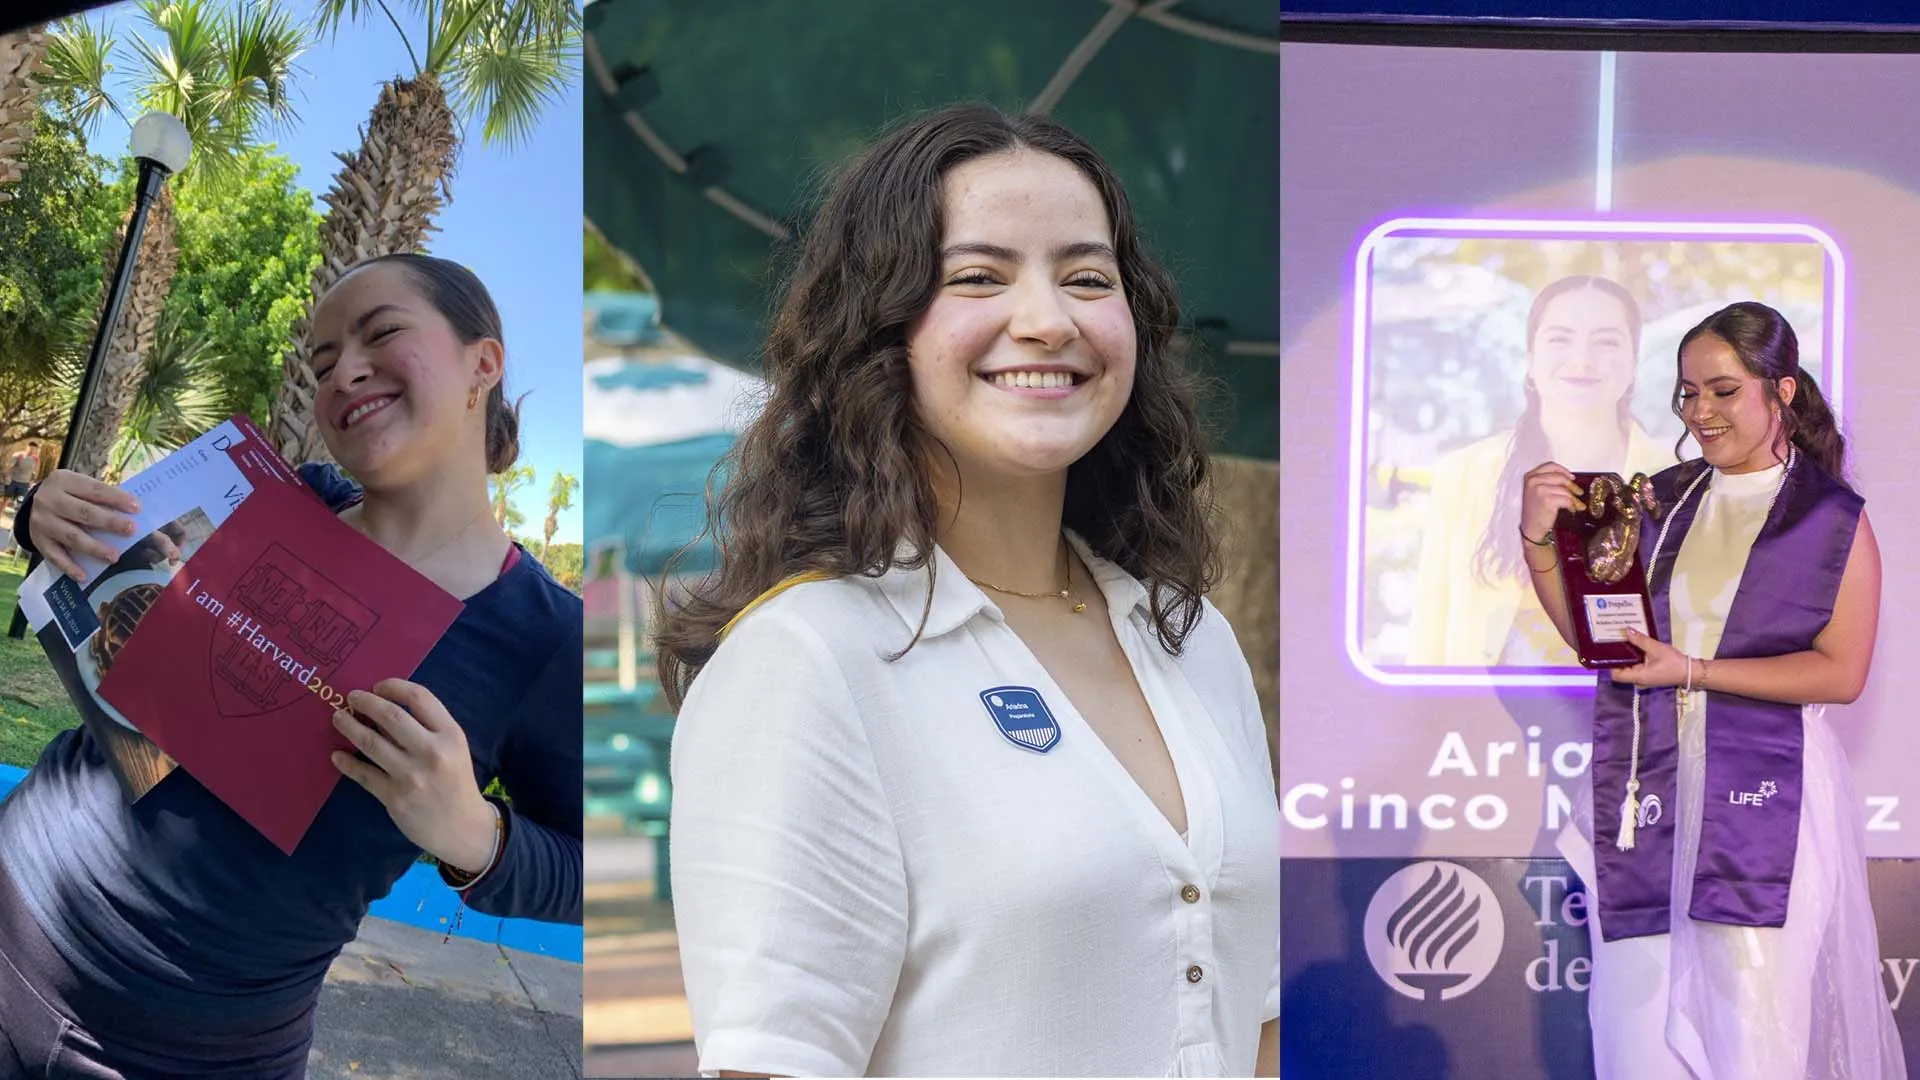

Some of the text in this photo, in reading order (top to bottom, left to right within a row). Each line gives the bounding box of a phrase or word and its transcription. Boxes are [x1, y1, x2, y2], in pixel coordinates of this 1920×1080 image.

[186, 579, 200, 595] I
[196, 591, 225, 617] am
[1428, 725, 1593, 777] Aria
[1283, 777, 1508, 830] Cinco
[1525, 939, 1593, 992] de
